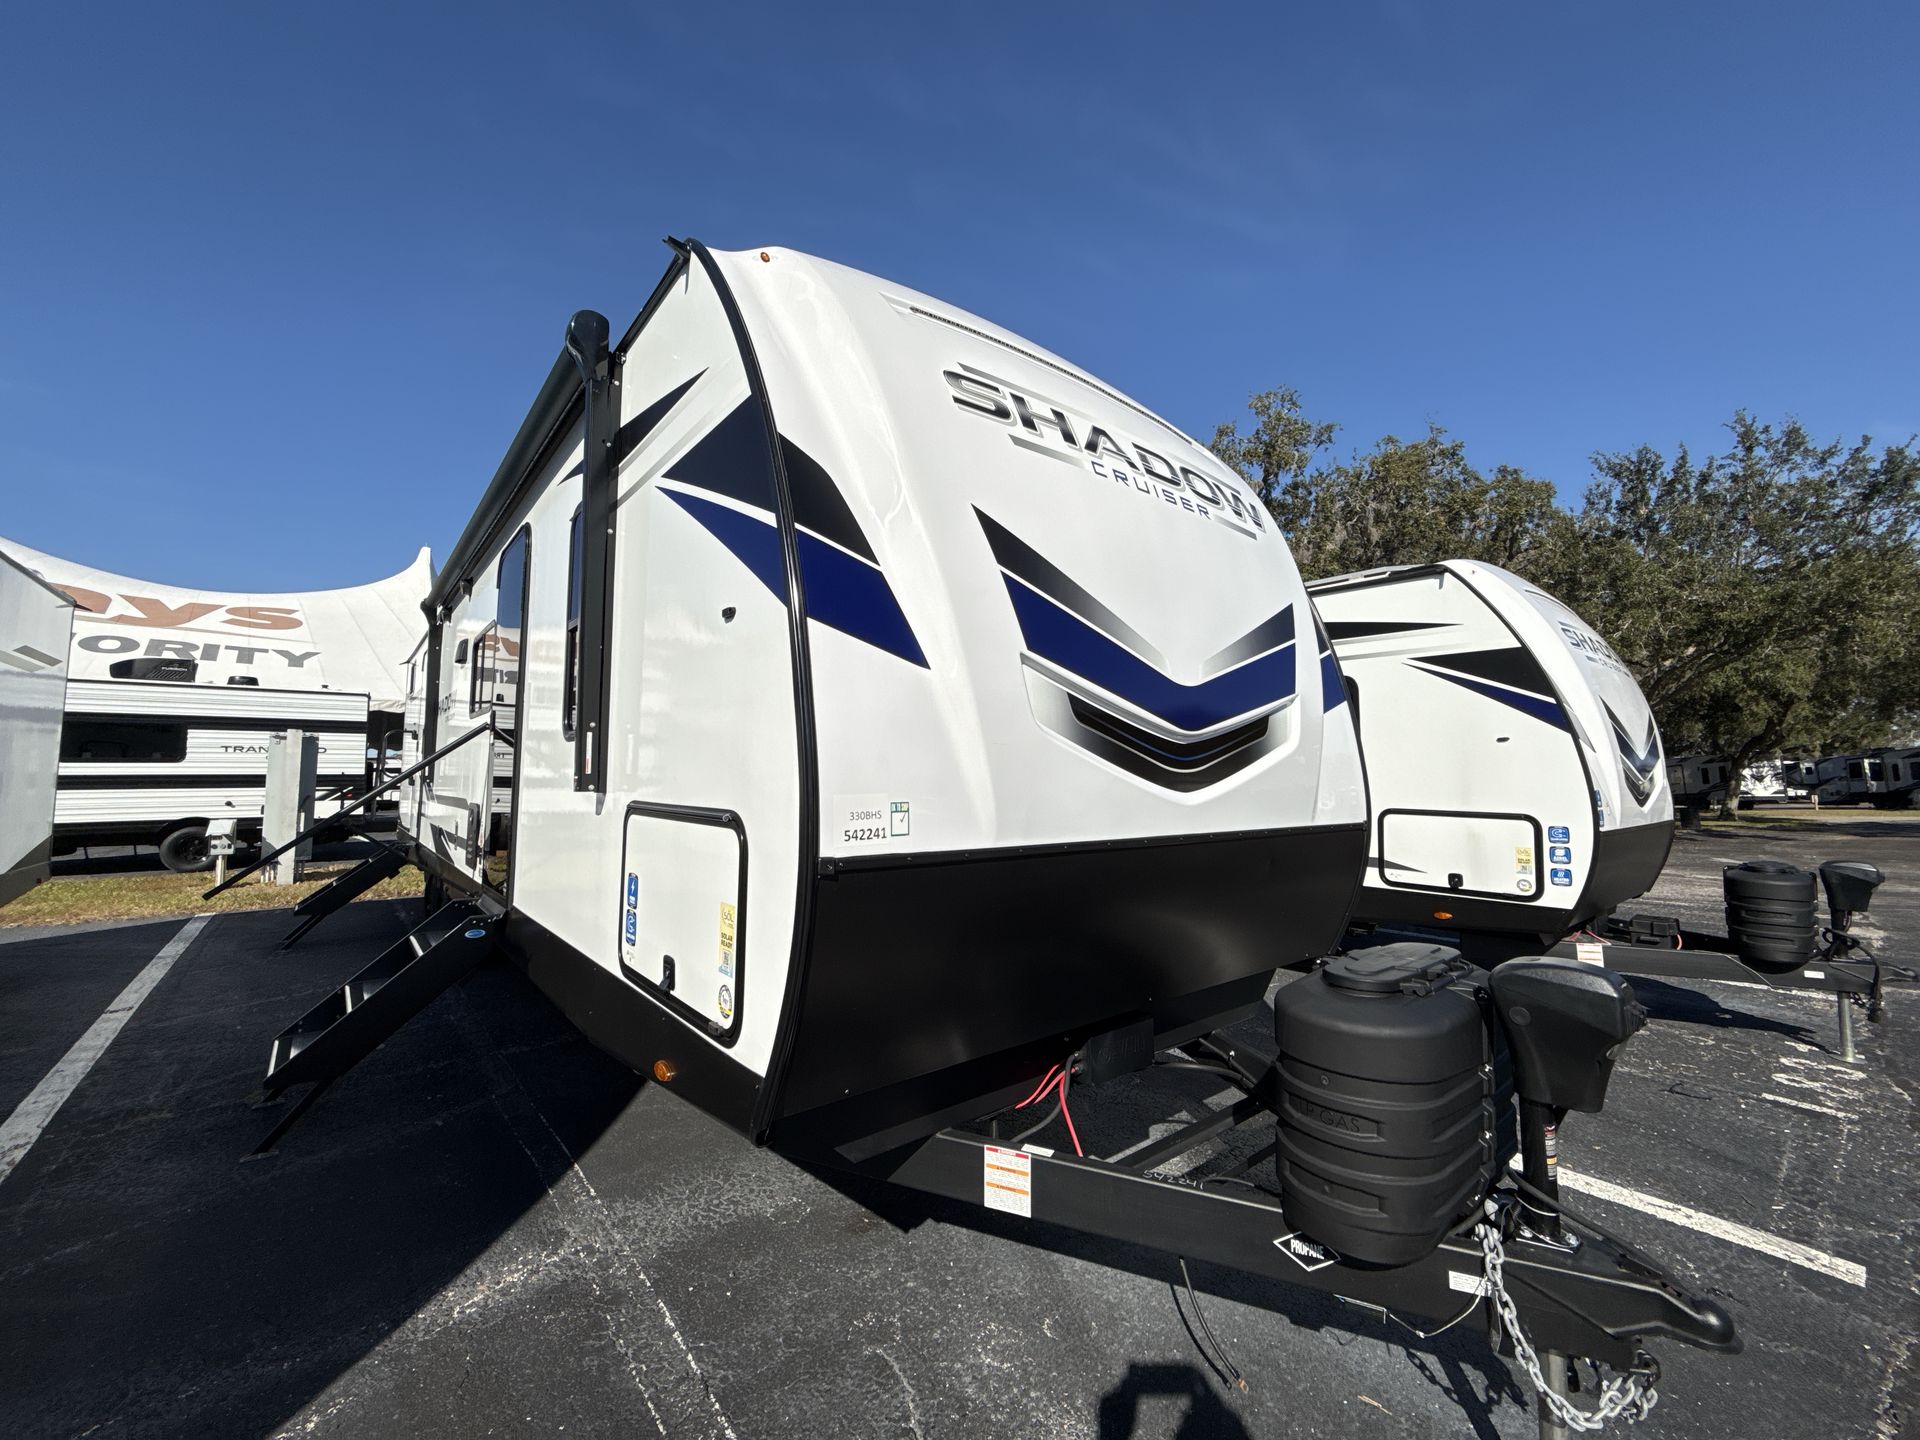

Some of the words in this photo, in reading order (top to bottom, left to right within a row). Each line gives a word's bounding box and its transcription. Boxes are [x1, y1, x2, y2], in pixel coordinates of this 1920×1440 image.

[943, 369, 1266, 533] SHADOW
[1091, 461, 1211, 520] CRUISER
[71, 632, 321, 668] ORITY
[849, 810, 882, 821] 330BHS
[844, 827, 887, 842] 542241
[1319, 1109, 1361, 1133] GAS
[1142, 1169, 1204, 1190] 542241
[1290, 1238, 1325, 1260] PROPANE
